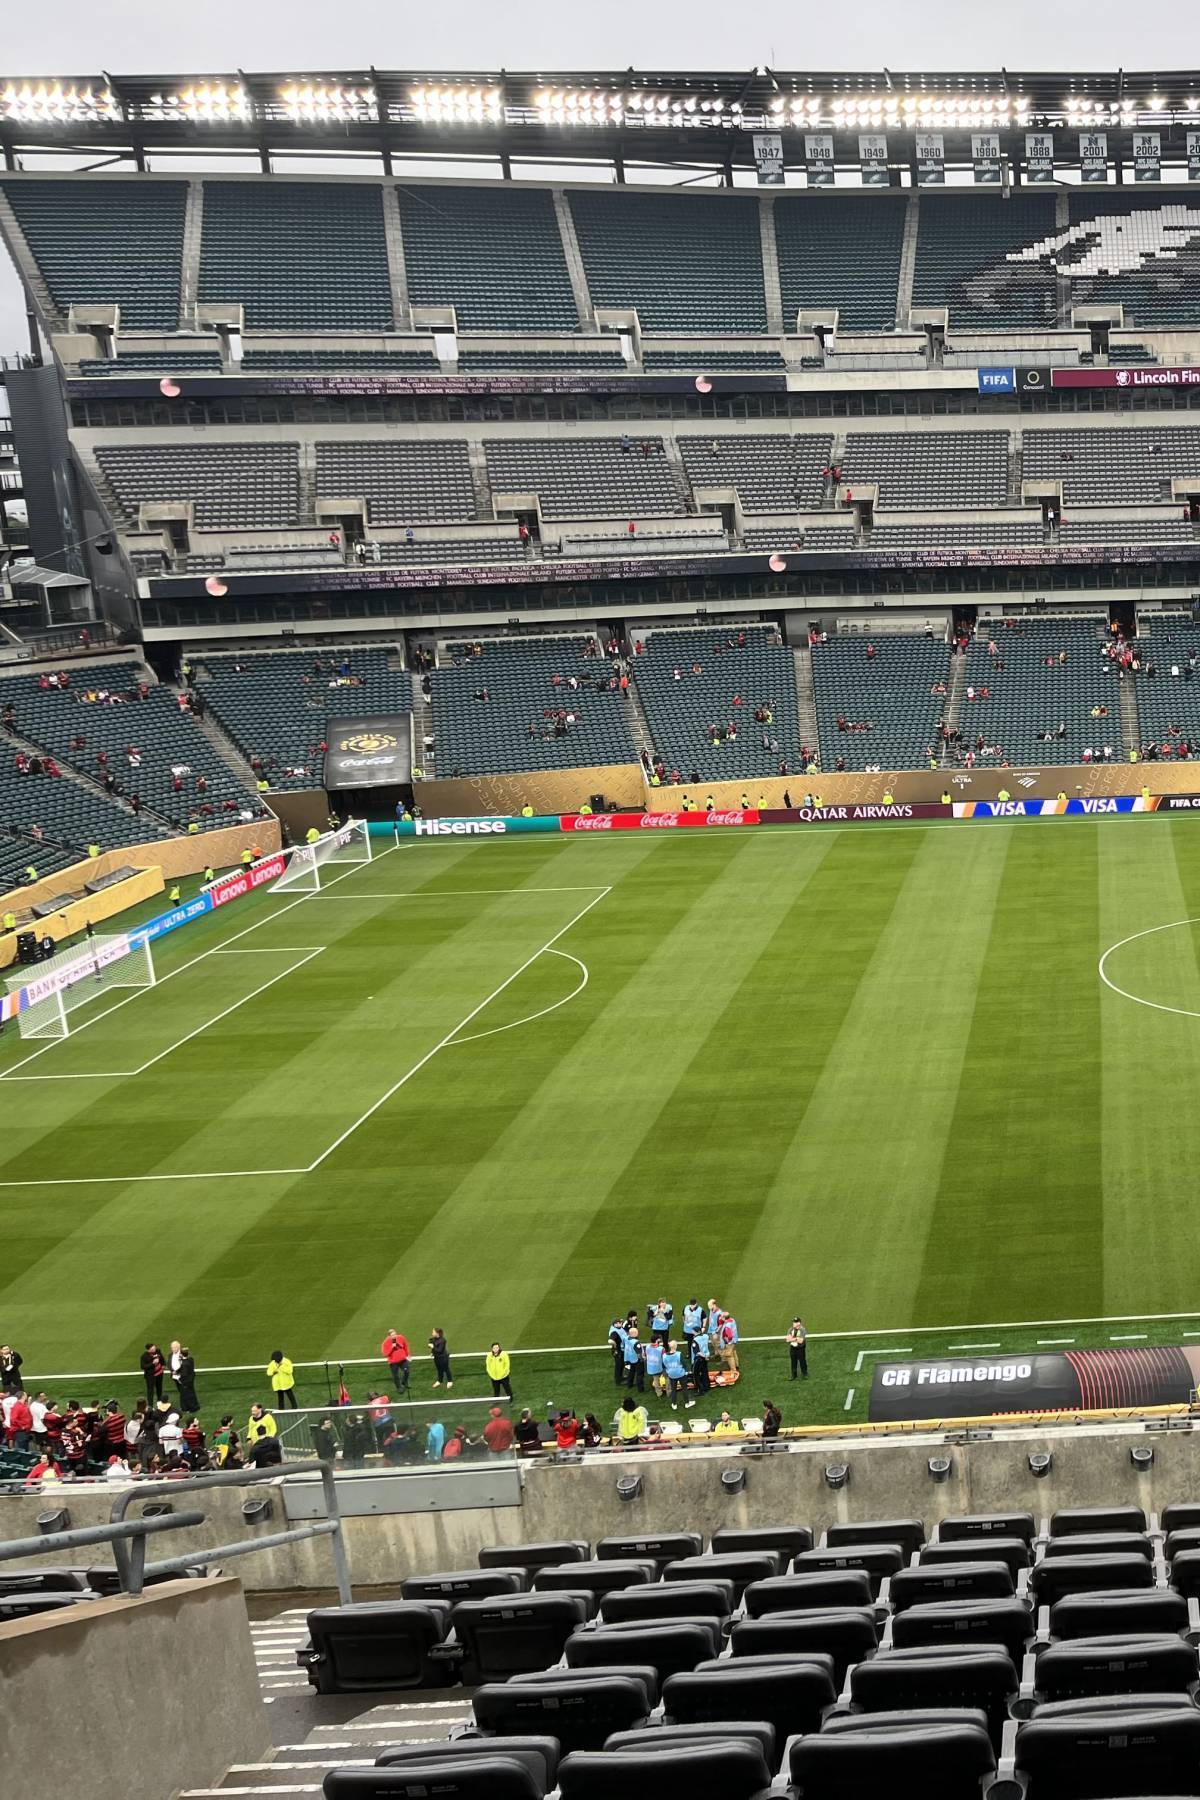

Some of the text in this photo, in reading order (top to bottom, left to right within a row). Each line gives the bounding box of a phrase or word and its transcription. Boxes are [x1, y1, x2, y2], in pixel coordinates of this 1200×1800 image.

[758, 148, 779, 158] 1947
[810, 148, 830, 158] 1948
[864, 148, 884, 158] 1949
[920, 148, 940, 157] 1960
[976, 147, 997, 156] 1980
[1030, 146, 1050, 156] 1988
[1083, 146, 1104, 156] 2001
[1136, 146, 1158, 156] 2002
[983, 375, 1008, 386] FIFA
[1133, 370, 1179, 384] Lincoln
[990, 802, 1026, 816] VISA
[1082, 799, 1118, 812] VISA
[1170, 797, 1190, 808] FIFA
[706, 811, 744, 825] Coca-Cola
[799, 804, 913, 822] QATAR AIRWAYS
[415, 818, 506, 836] Hisense
[574, 816, 612, 830] Coca-Cola
[640, 814, 680, 828] Coca-Cola
[250, 862, 282, 887] Lenovo
[214, 879, 248, 906] Lenovo
[164, 900, 206, 930] ULTRA ZERO
[882, 1363, 1032, 1386] CR Flamengo
